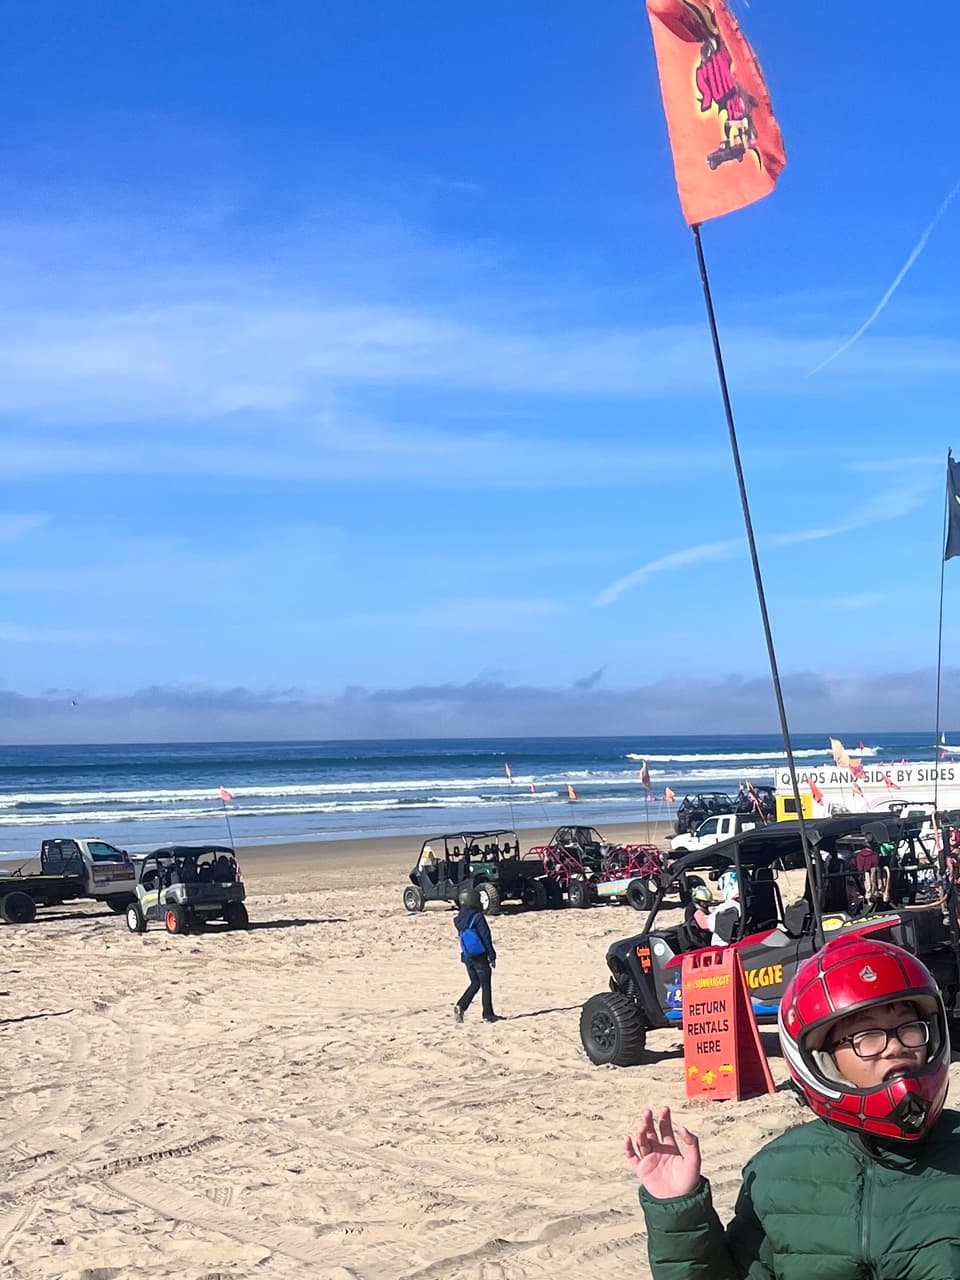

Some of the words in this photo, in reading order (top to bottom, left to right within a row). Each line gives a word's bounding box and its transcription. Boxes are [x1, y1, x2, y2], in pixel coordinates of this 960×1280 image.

[863, 769, 893, 783] SIDE
[897, 769, 913, 782] BY
[917, 768, 955, 782] SIDES
[689, 1000, 726, 1016] RETURN
[687, 1020, 729, 1036] RENTALS
[696, 1040, 721, 1054] HERE
